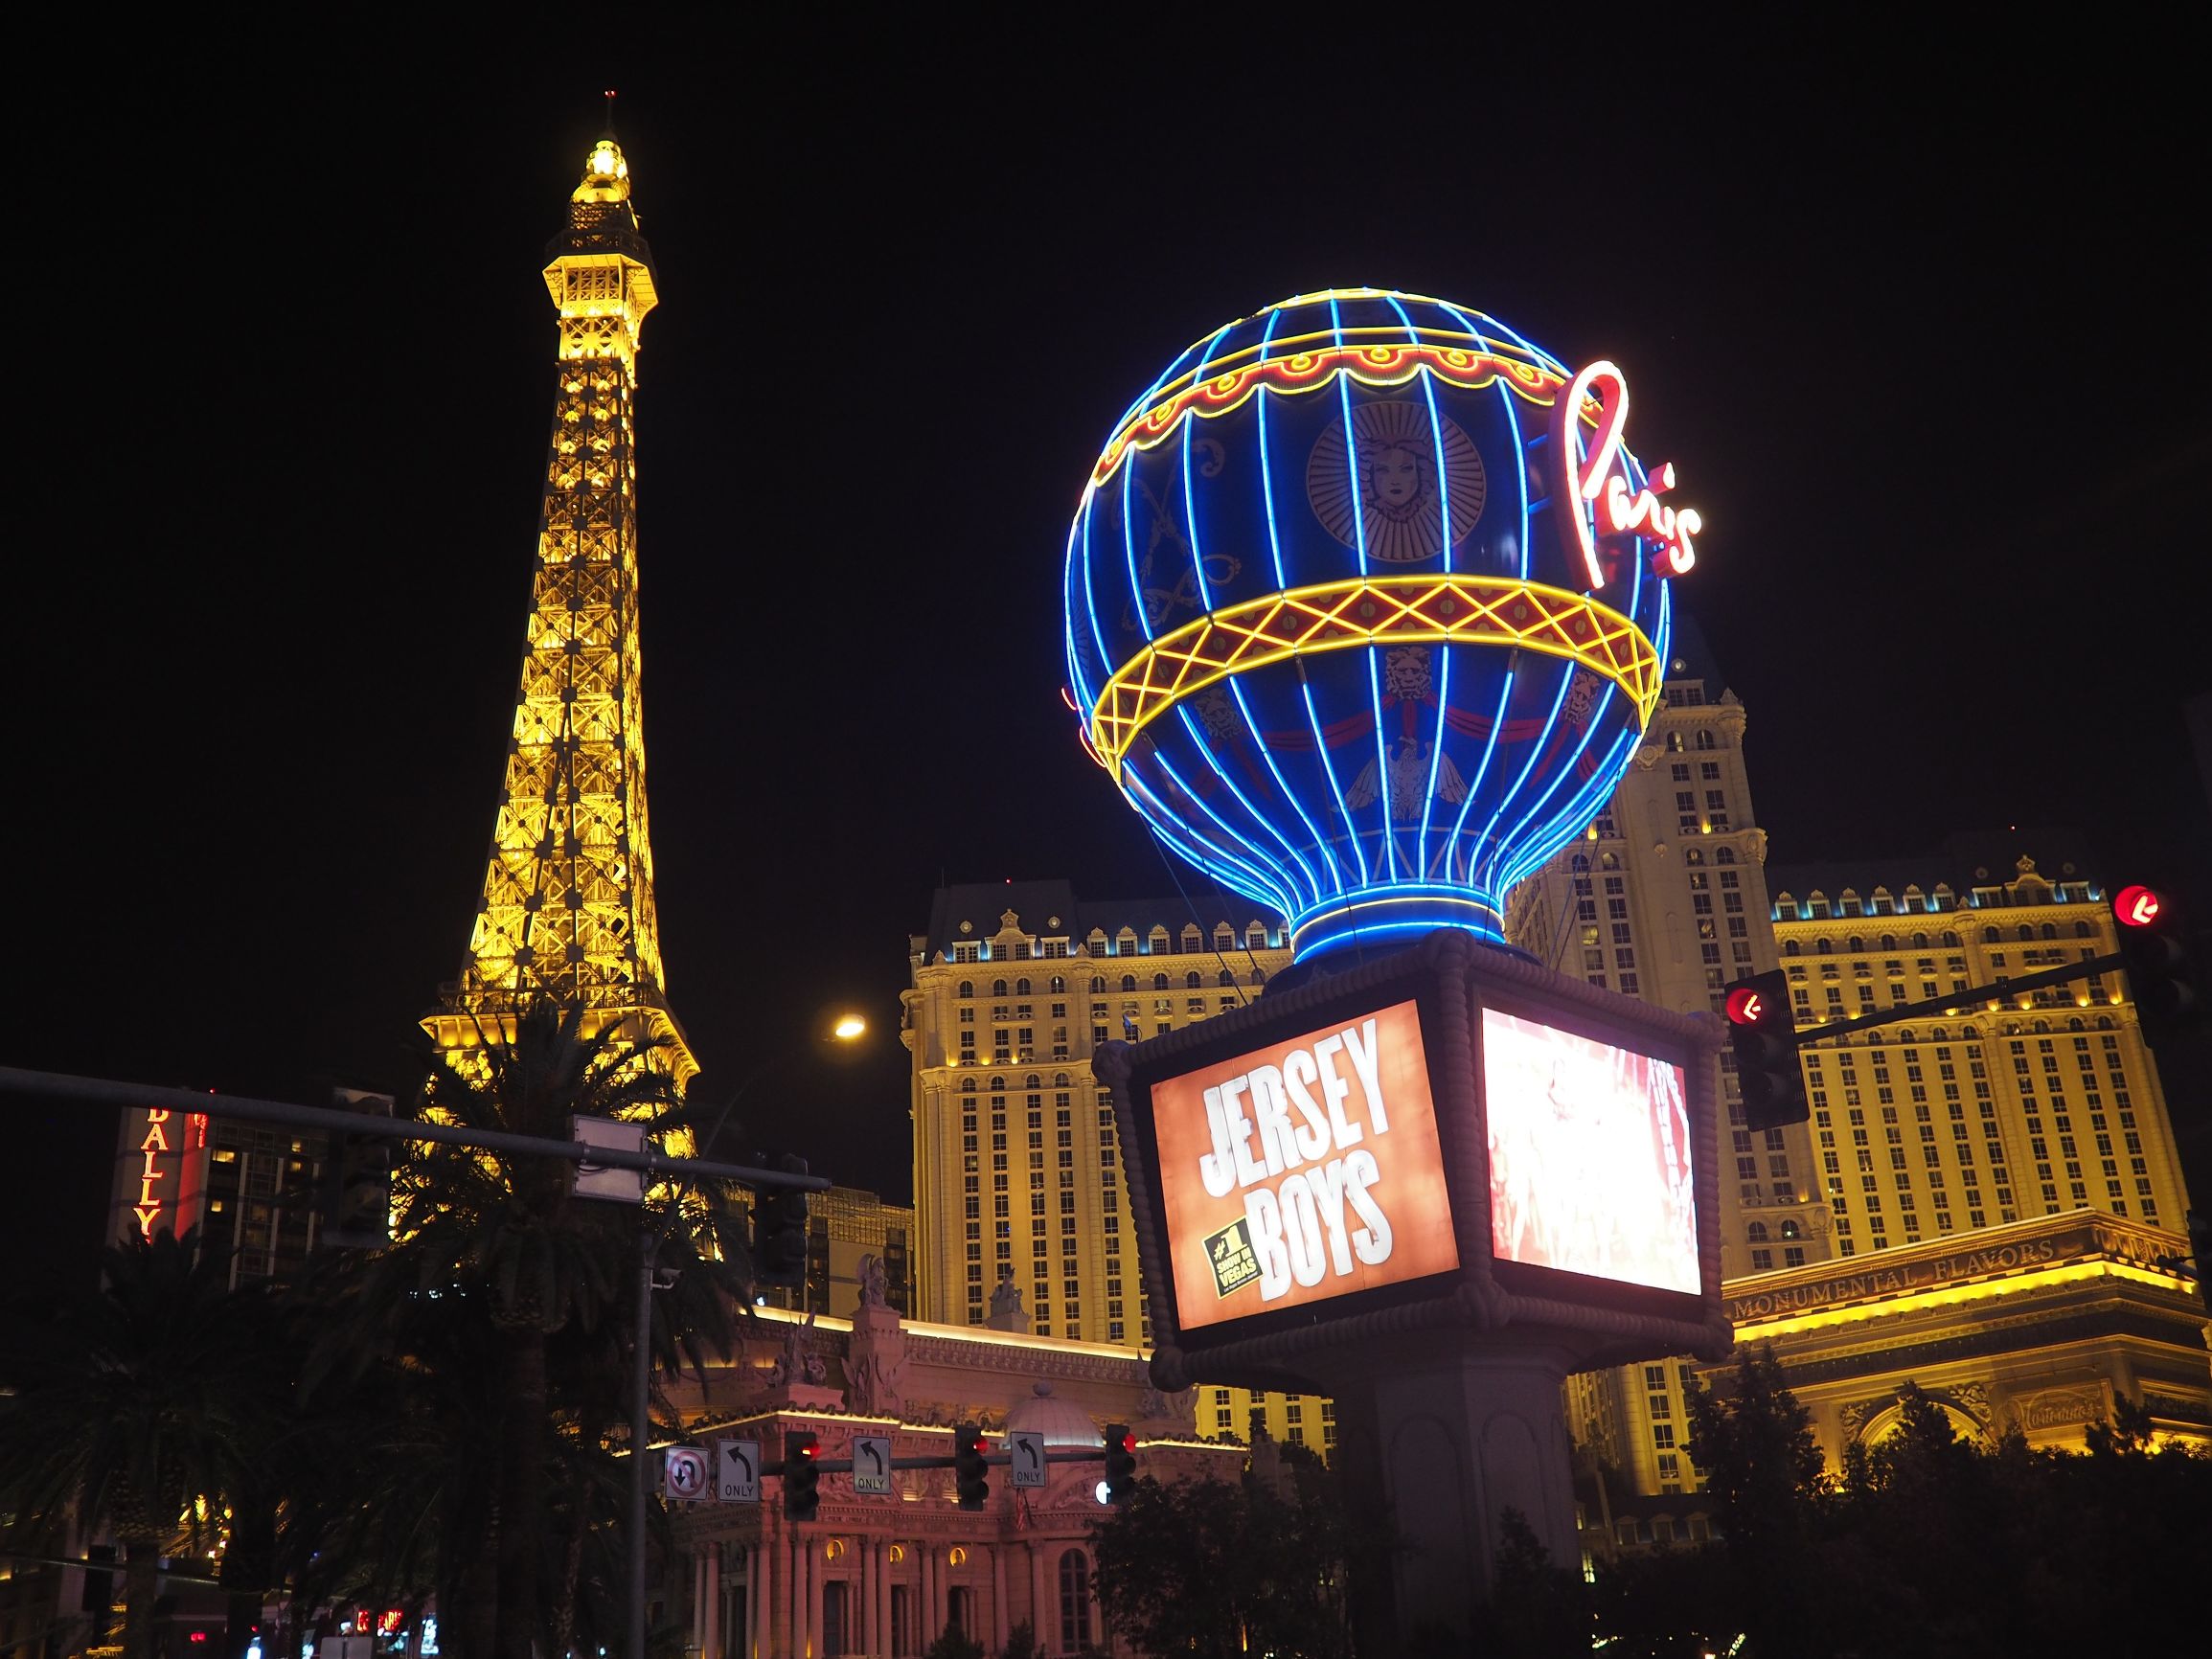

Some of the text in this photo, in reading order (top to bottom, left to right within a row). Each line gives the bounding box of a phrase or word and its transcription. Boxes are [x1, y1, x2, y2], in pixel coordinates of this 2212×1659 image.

[1563, 360, 1702, 589] Paris
[1198, 1018, 1389, 1197] JERSEY
[1243, 1149, 1393, 1303] BOYS
[1213, 1225, 1247, 1261] #1
[1217, 1246, 1252, 1274] SHOW IN
[1219, 1258, 1257, 1287] VEGAS
[1732, 1240, 2056, 1319] MONUMENTAL FLAVORS
[725, 1485, 755, 1497] ONLY
[858, 1477, 884, 1490] ONLY
[1016, 1470, 1040, 1483] ONLY
